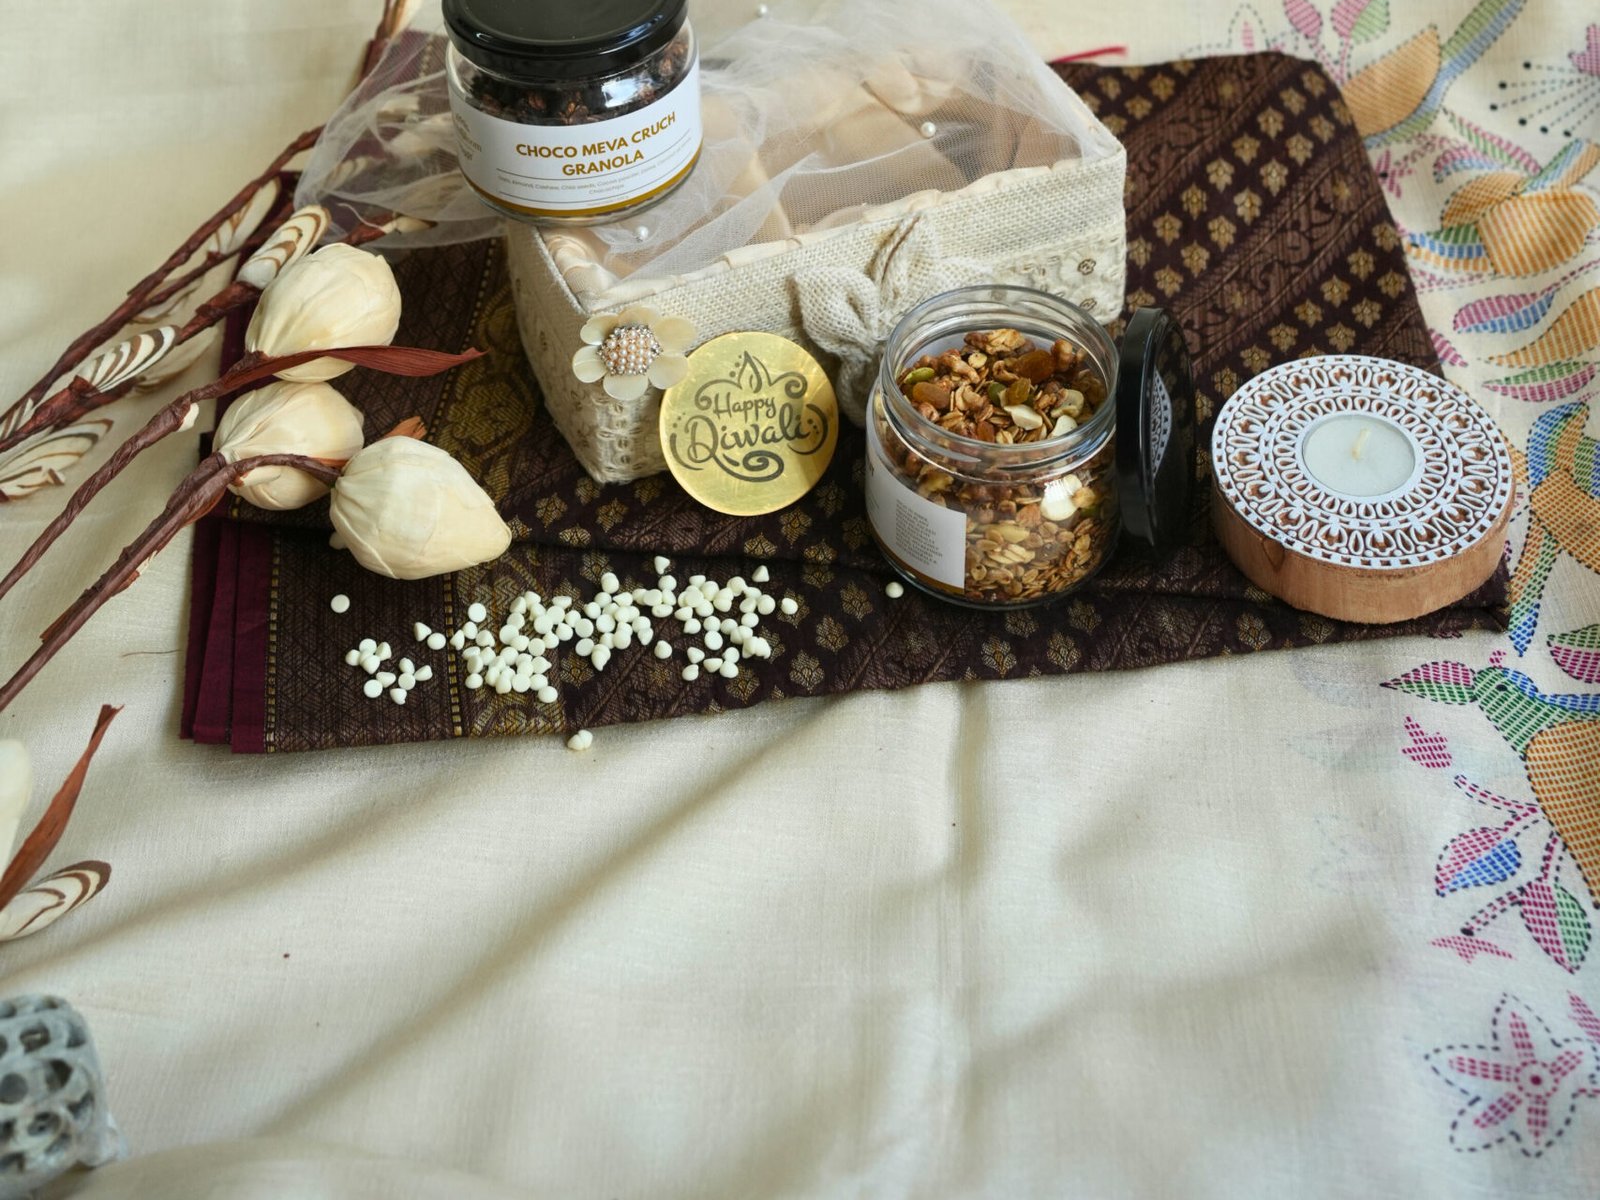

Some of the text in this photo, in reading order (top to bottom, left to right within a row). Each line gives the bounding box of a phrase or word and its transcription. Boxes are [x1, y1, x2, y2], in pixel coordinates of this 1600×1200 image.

[515, 143, 578, 158] CHOCO
[582, 137, 629, 157] MEVA
[631, 111, 676, 144] CRUCH
[562, 149, 644, 176] GRANOLA
[712, 391, 777, 422] Happy
[685, 402, 811, 466] Diwali
